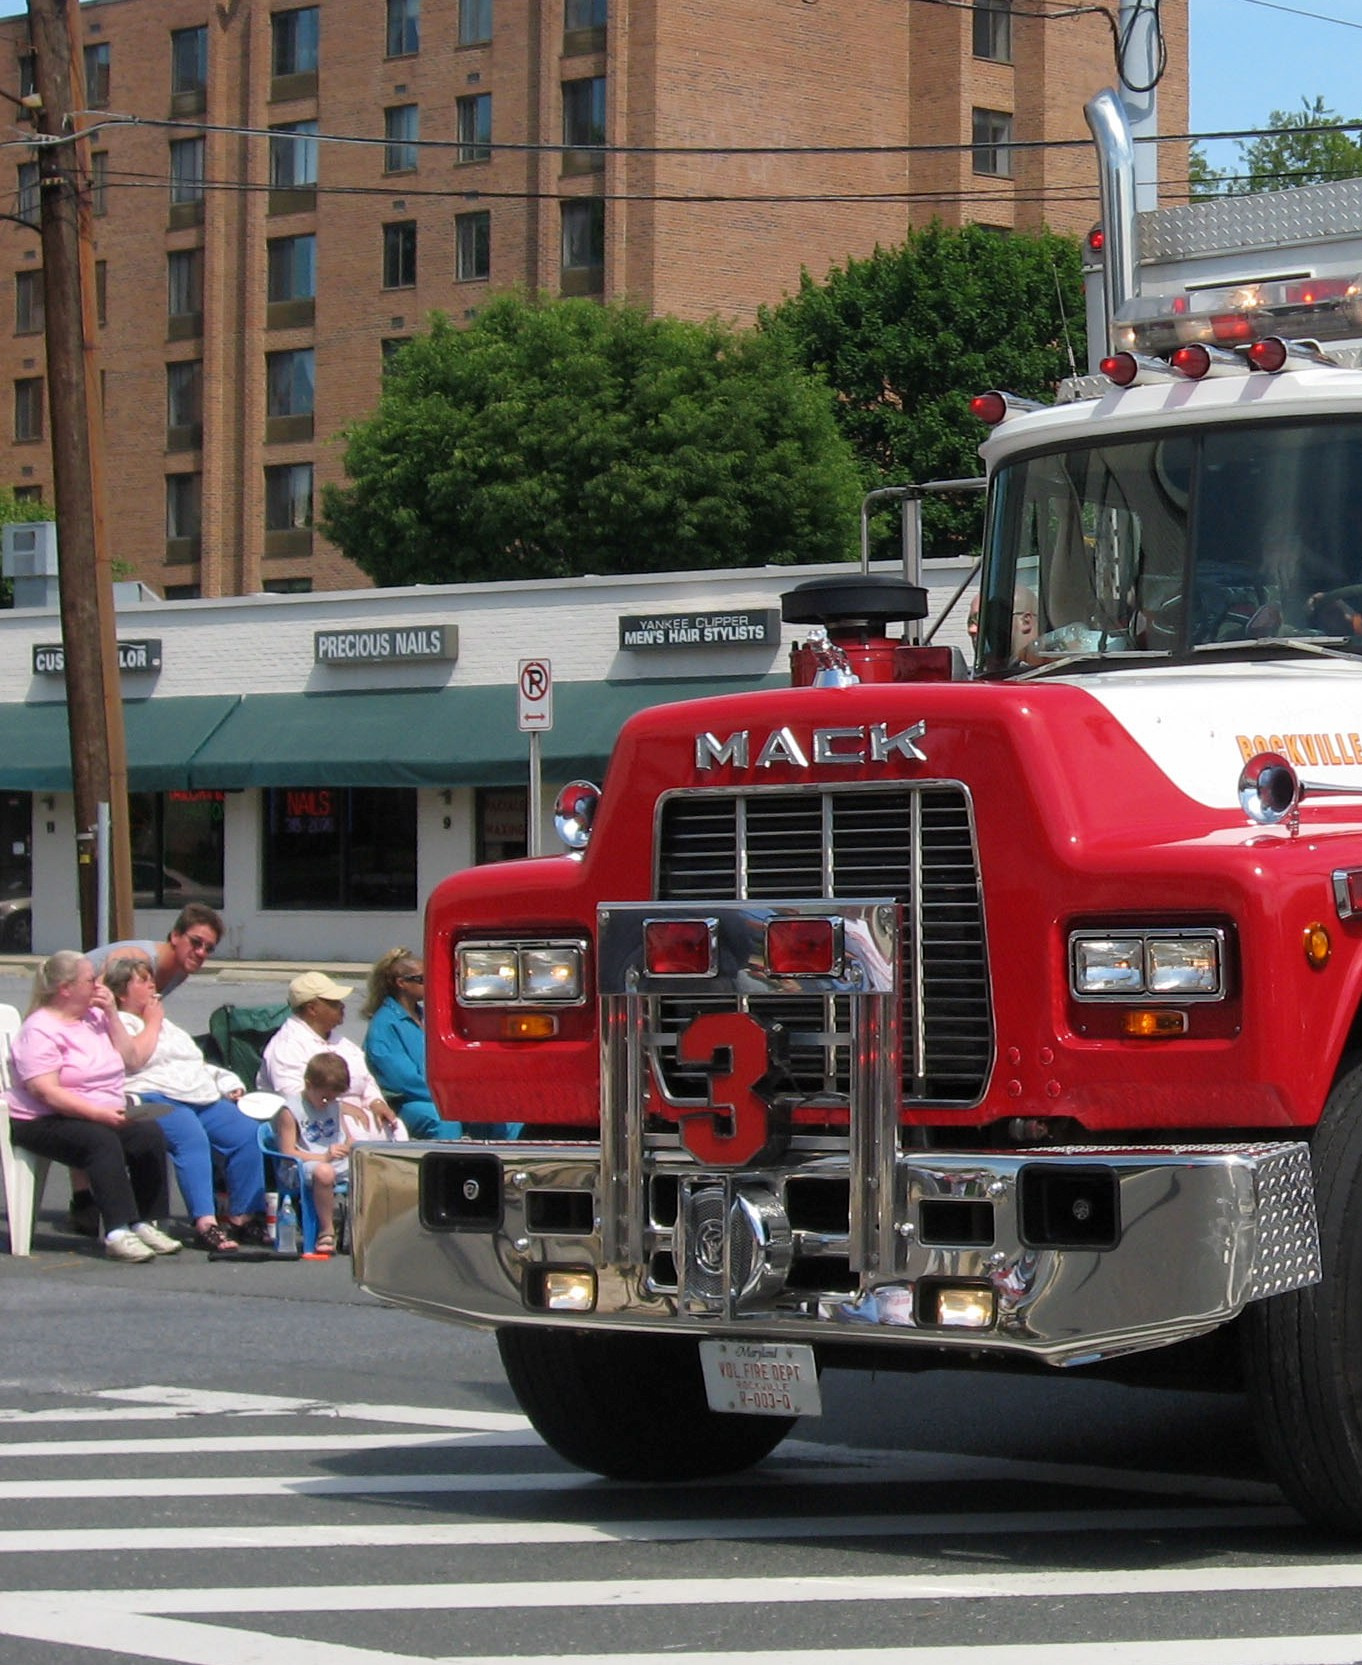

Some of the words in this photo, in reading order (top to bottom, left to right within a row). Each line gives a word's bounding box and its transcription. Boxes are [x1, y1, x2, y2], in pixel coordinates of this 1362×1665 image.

[639, 618, 689, 630] YANKEE
[695, 615, 749, 628] CLIPPER
[318, 633, 390, 659] PRECIOUS
[395, 630, 441, 655] NAILS
[624, 630, 665, 645] MEN'S
[668, 627, 700, 643] HAIR
[703, 625, 764, 642] STYLISTS
[36, 652, 65, 671] CUS
[118, 650, 146, 668] LOR
[695, 719, 928, 770] MACK
[287, 790, 330, 816] NAILS
[677, 1012, 768, 1167] 3
[744, 1363, 768, 1379] FIRE
